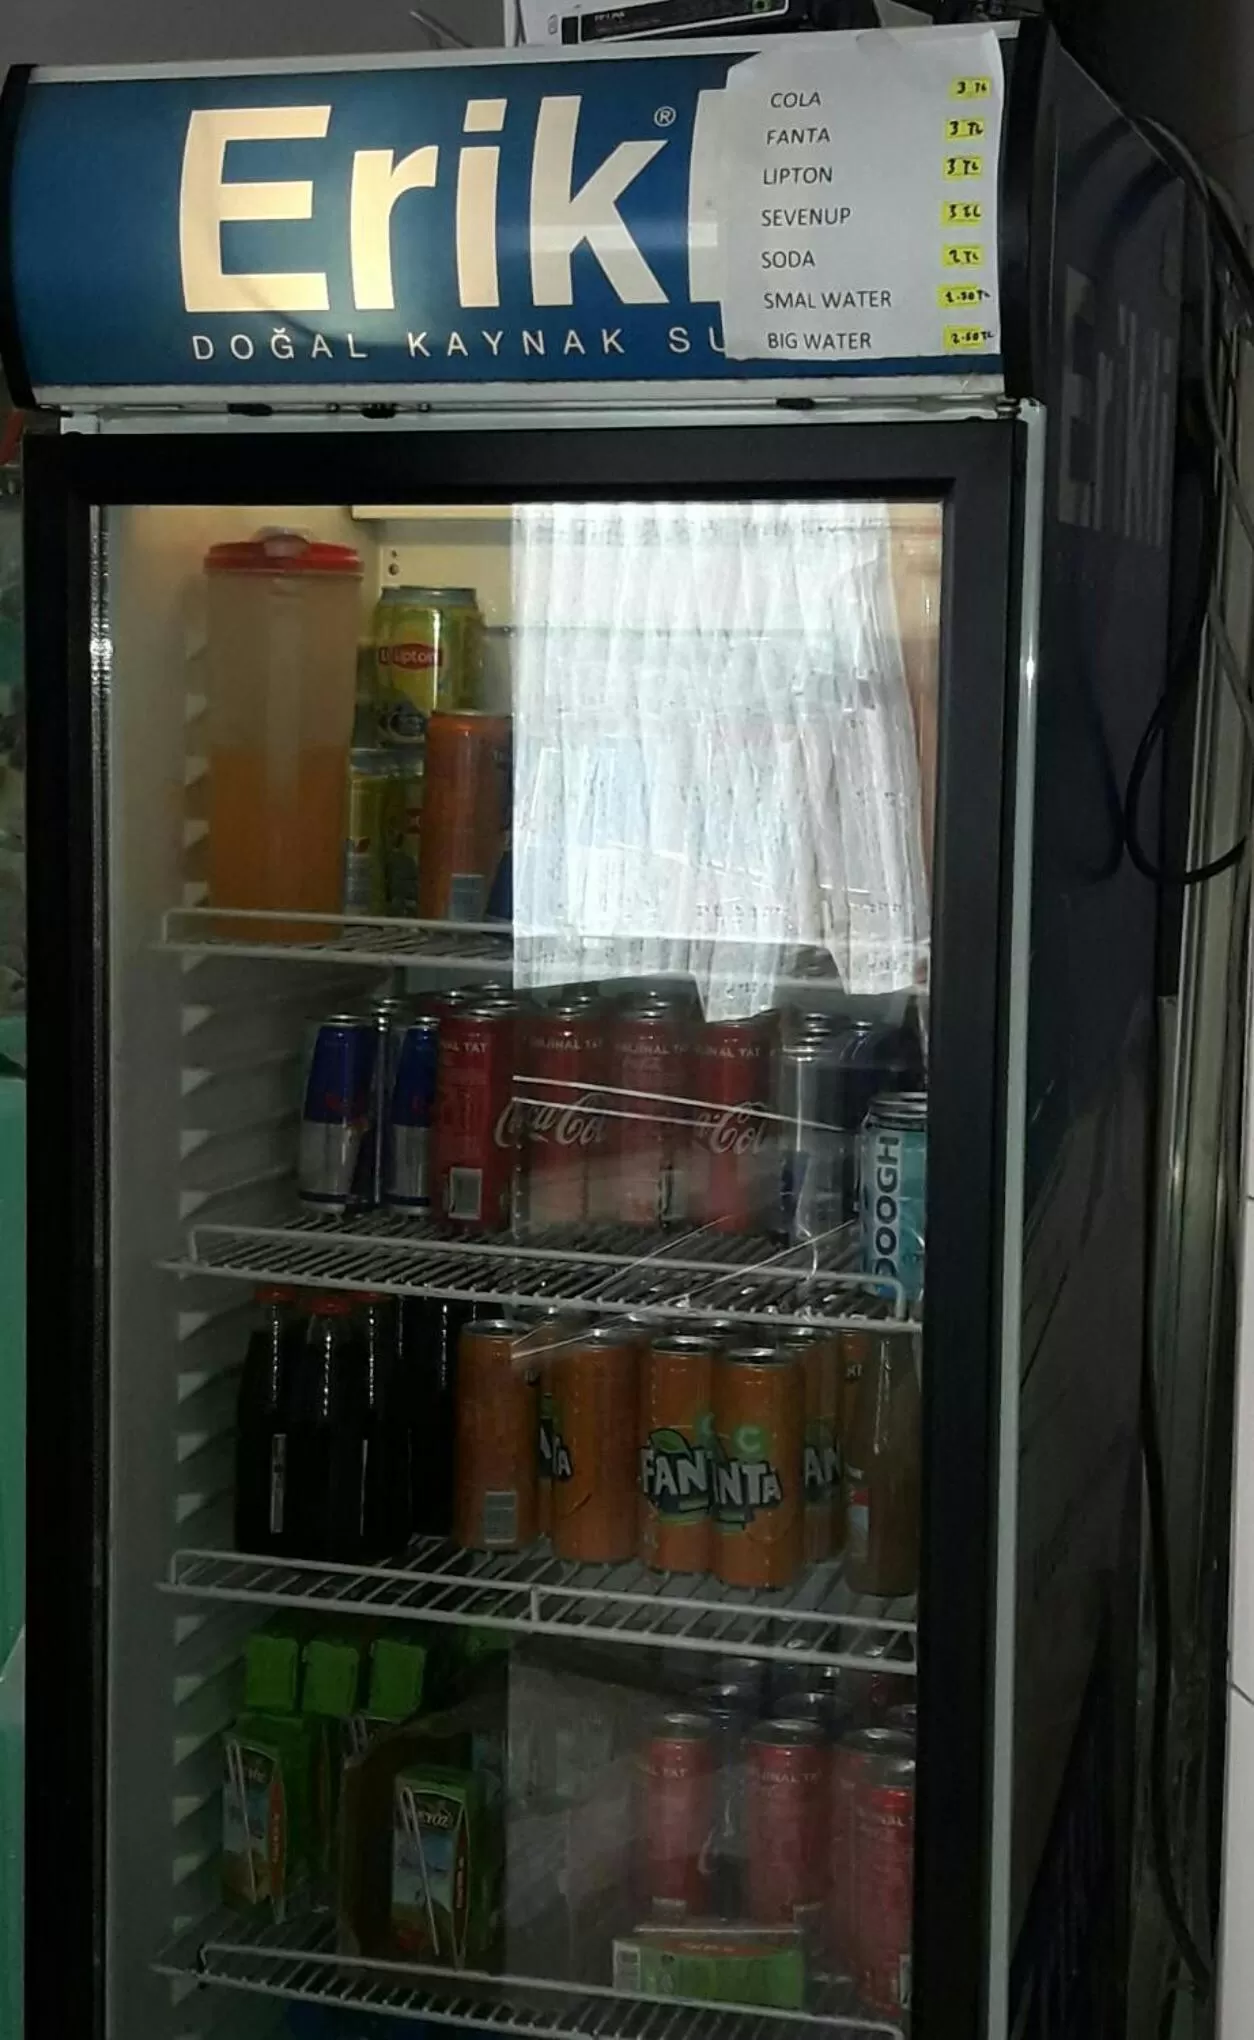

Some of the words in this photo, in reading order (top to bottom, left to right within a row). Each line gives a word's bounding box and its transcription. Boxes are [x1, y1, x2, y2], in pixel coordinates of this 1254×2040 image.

[769, 91, 822, 108] COLA
[956, 81, 966, 95] 3
[766, 127, 831, 145] FANTA
[949, 120, 960, 136] 3
[763, 165, 833, 185] LIPTON
[946, 158, 957, 175] 3
[761, 207, 852, 227] SEVENUP
[761, 250, 816, 269] SODA
[949, 249, 960, 264] 2
[763, 291, 817, 310] SMAL
[821, 289, 892, 309] WATER
[192, 326, 369, 361] DOĞAL
[407, 327, 625, 358] KAYNAK
[767, 331, 798, 349] BIG
[803, 331, 872, 350] WATER
[641, 1448, 713, 1497] FAN
[711, 1460, 782, 1506] NTA
